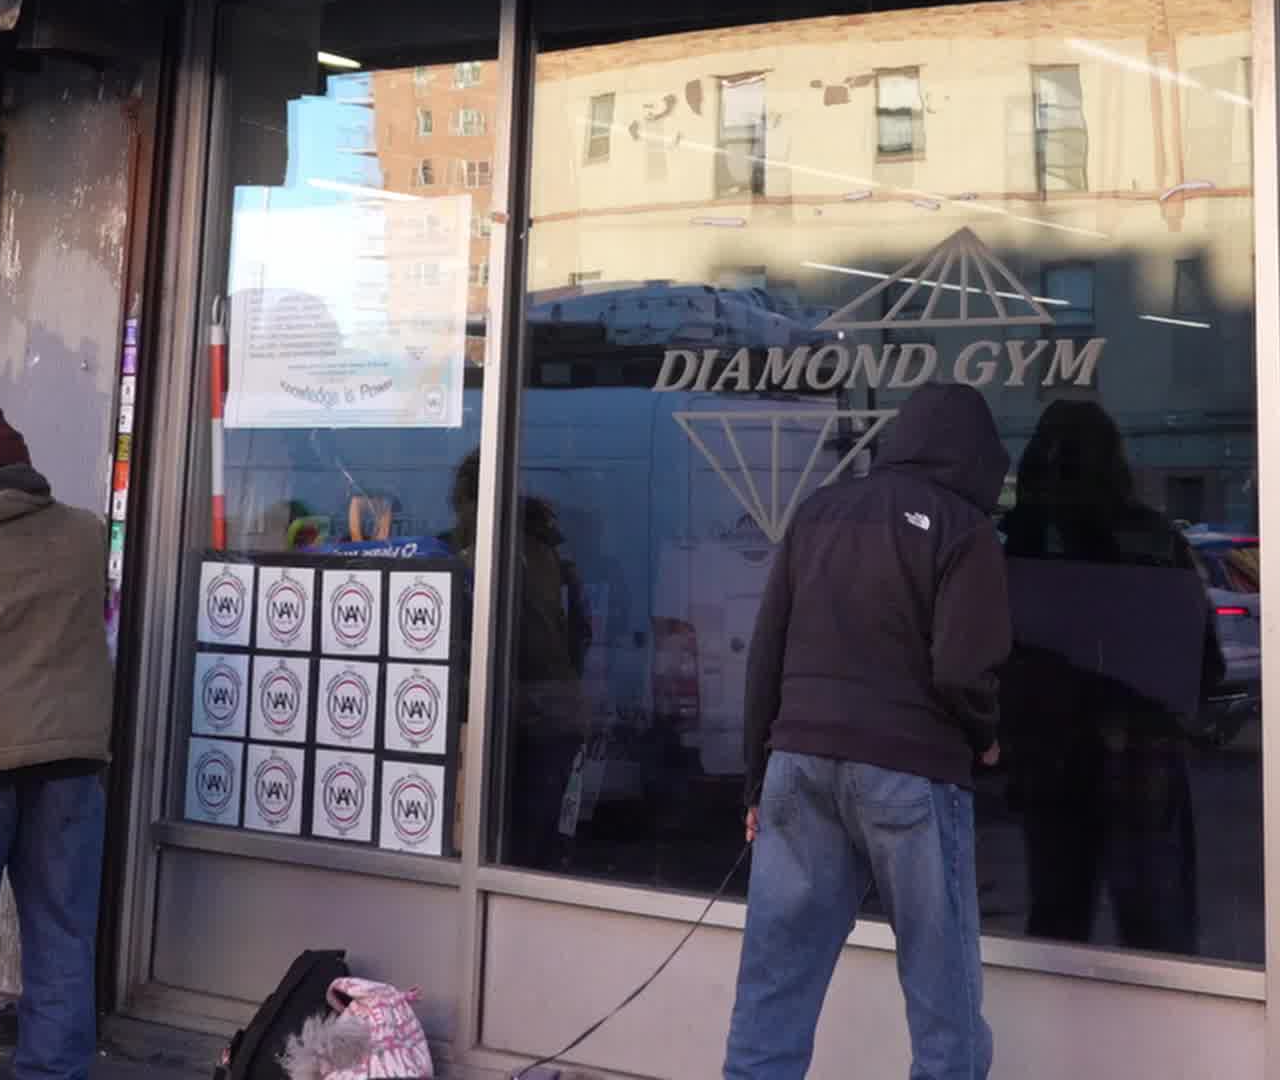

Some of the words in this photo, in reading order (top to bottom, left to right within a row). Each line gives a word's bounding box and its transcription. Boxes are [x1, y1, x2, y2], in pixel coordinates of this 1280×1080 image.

[652, 341, 938, 394] DIAMOND
[954, 337, 1108, 387] GYM
[360, 378, 392, 401] Power
[212, 595, 239, 614] NAN
[272, 600, 299, 619] NAN
[337, 604, 367, 622] NAN
[405, 607, 435, 626] NAN
[207, 686, 234, 705] NAN
[267, 691, 294, 709] NAN
[333, 695, 362, 713] NAN
[401, 700, 432, 718] NAN
[201, 773, 228, 792] NAN
[261, 778, 288, 797] NAN
[328, 785, 358, 806] NAN
[397, 801, 428, 820] NAN
